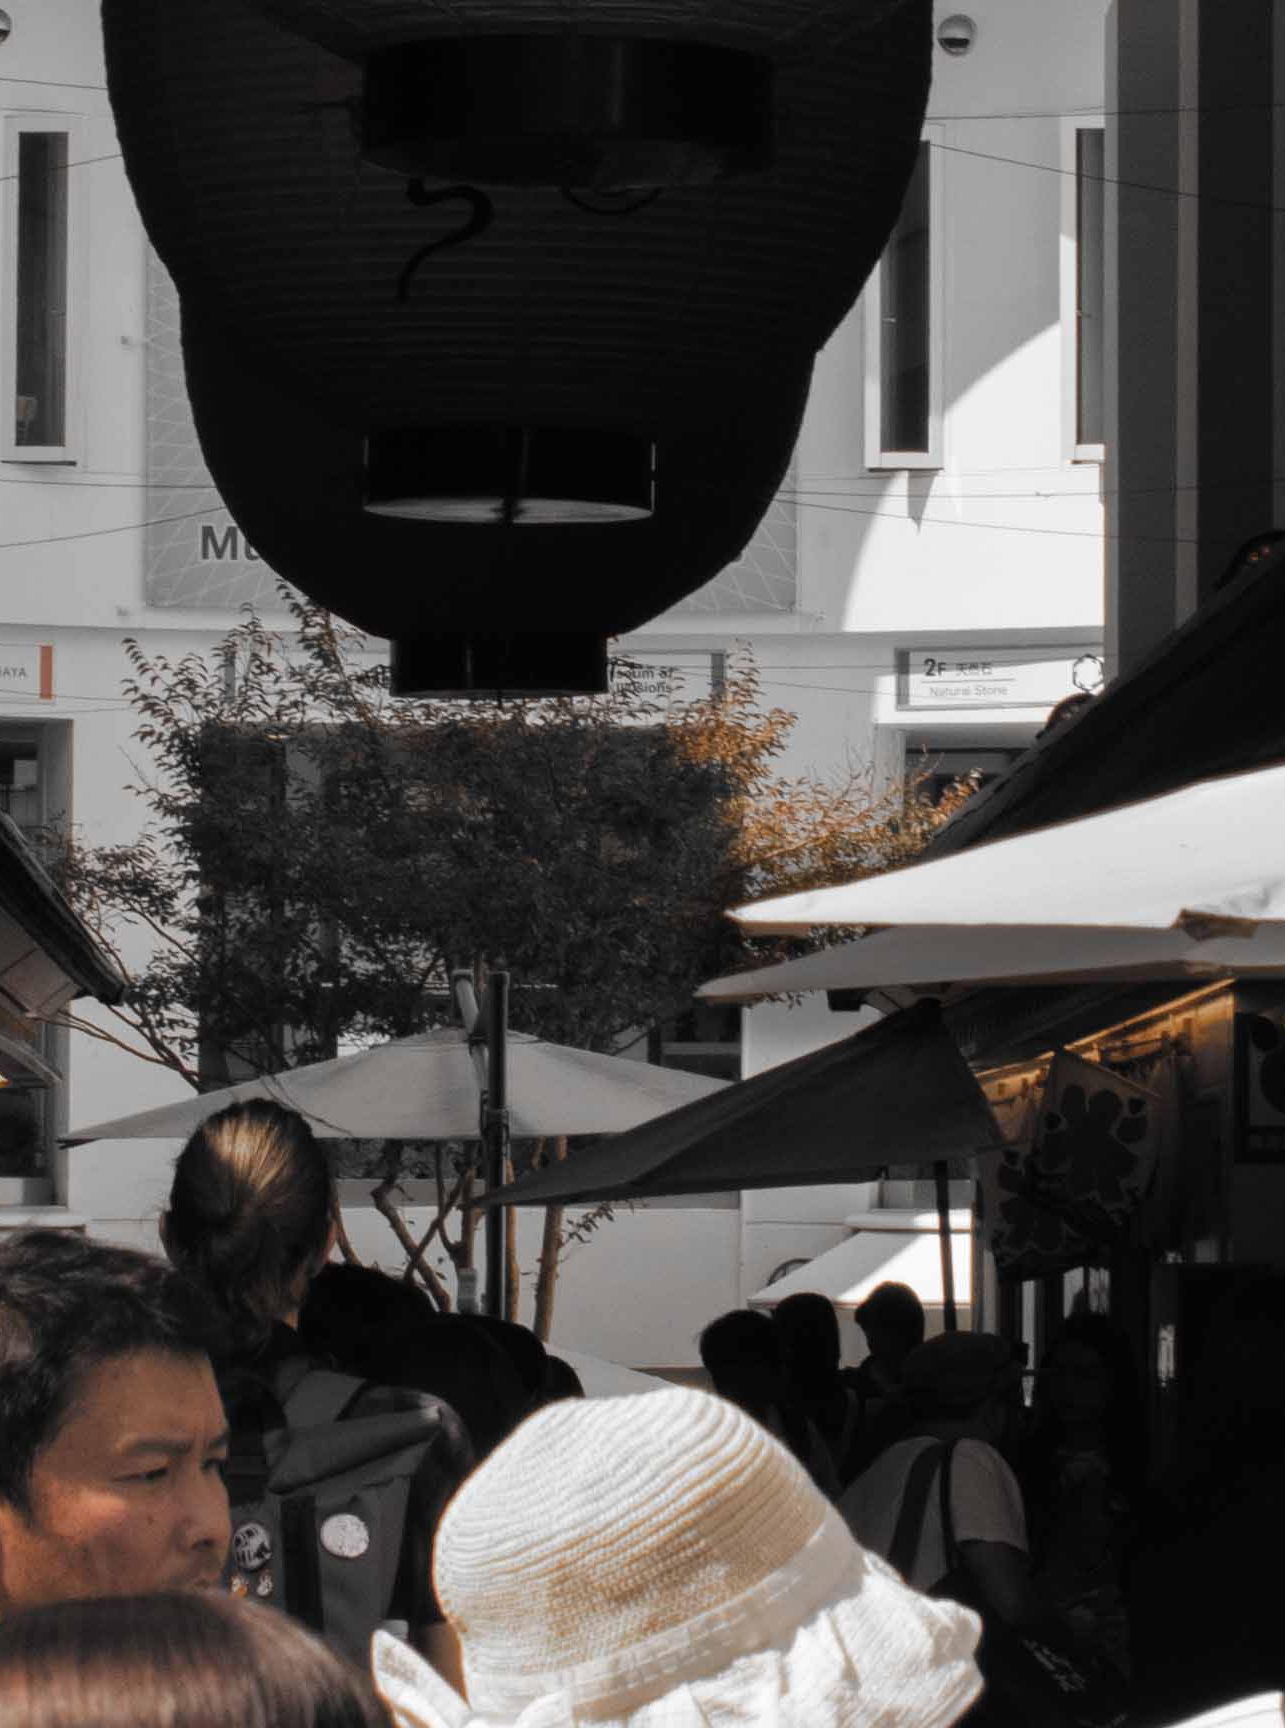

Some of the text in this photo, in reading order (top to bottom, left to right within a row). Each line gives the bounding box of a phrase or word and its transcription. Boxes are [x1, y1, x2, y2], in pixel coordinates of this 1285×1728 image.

[923, 657, 947, 677] 2F
[929, 683, 1010, 697] Natural Stone
